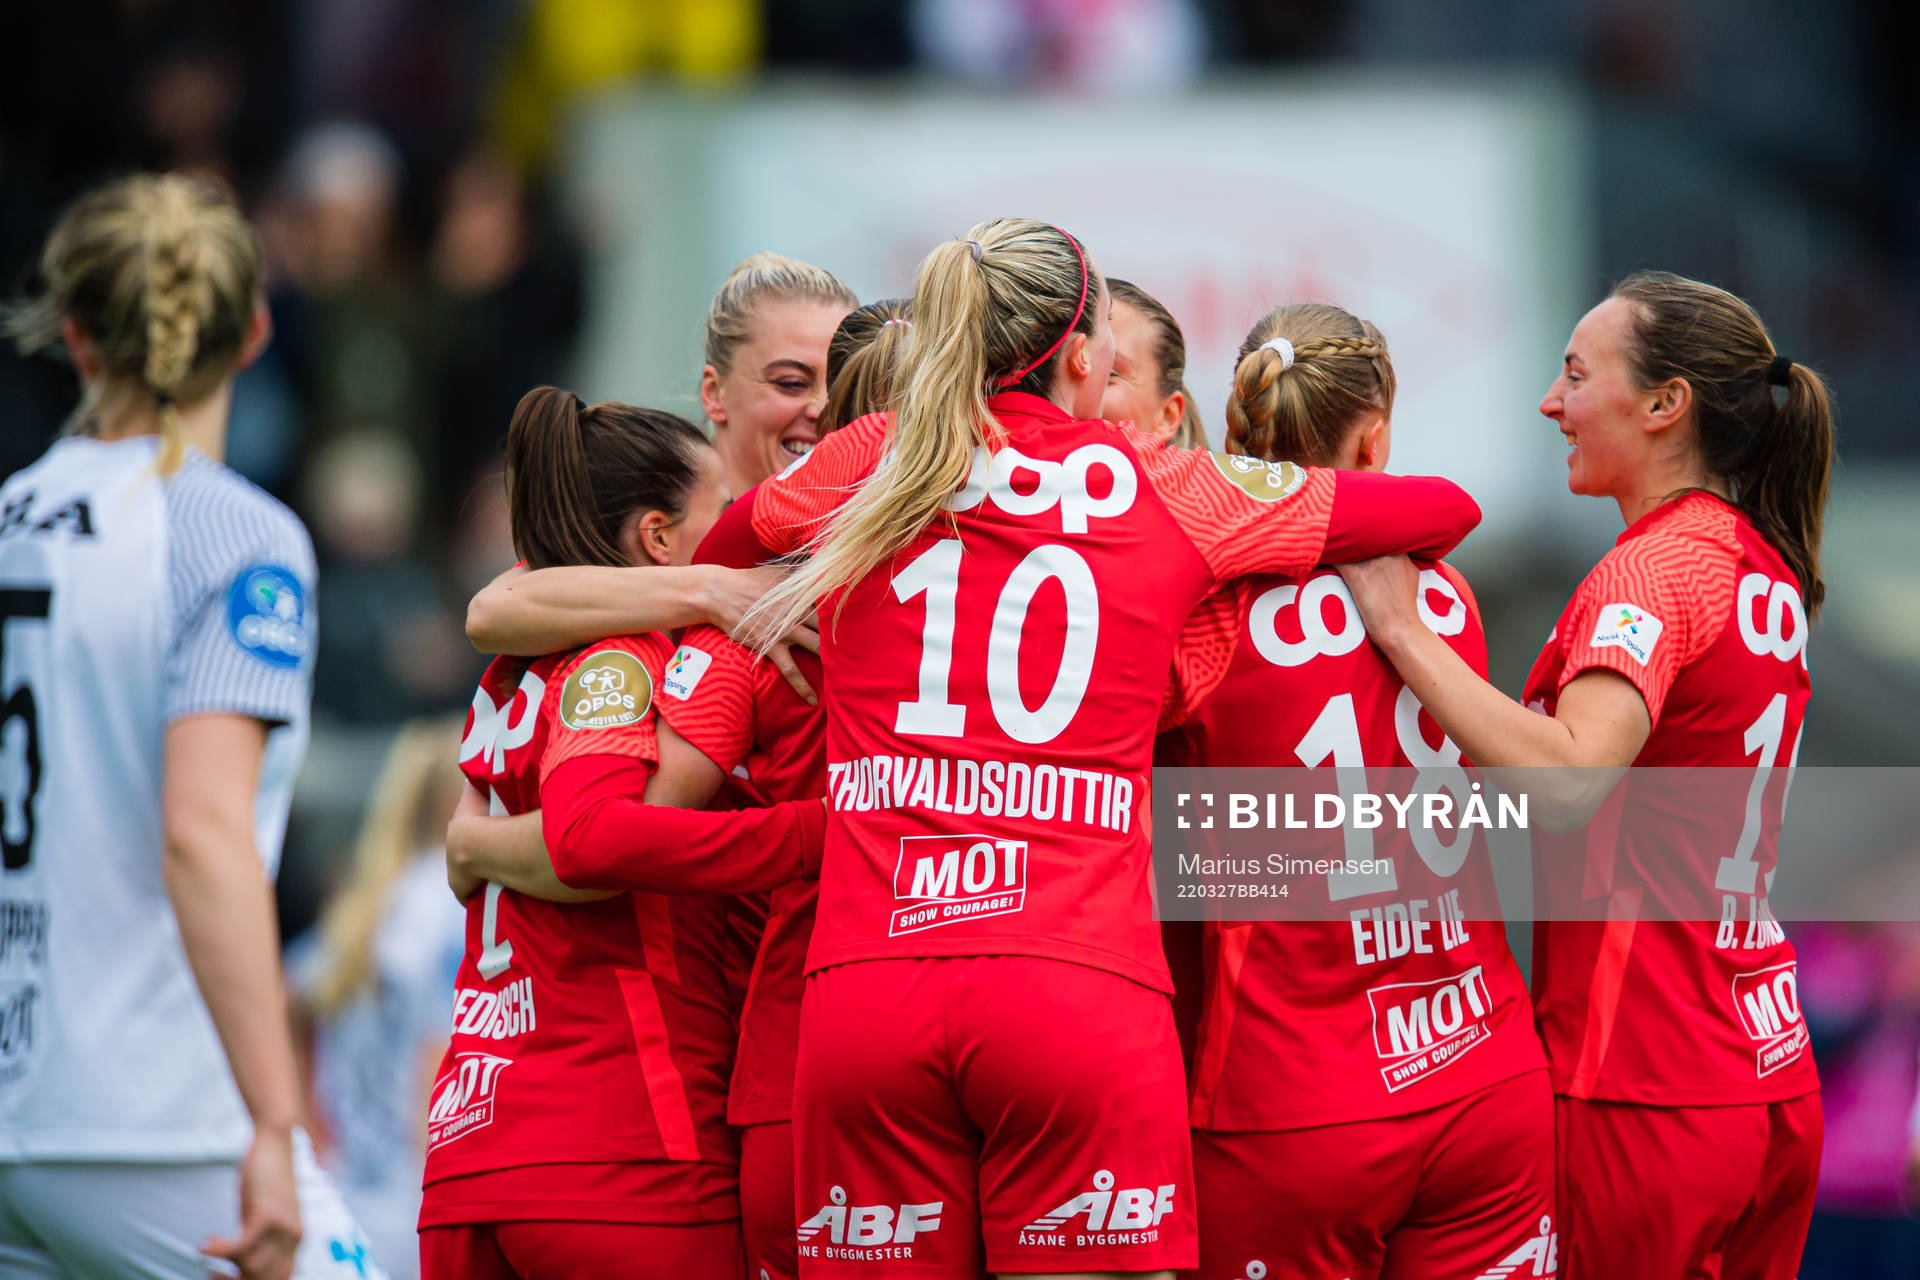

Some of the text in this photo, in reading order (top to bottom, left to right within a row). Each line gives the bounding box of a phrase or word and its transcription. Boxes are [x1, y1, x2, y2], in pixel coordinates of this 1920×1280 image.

[891, 539, 1099, 744] 10
[1622, 633, 1646, 660] Tipping
[575, 692, 635, 715] OBOS
[828, 755, 1132, 834] THORVALDSDOTTIR
[910, 841, 1027, 898] MOT
[900, 896, 1014, 928] SHOW COURAGE!
[1350, 889, 1470, 965] EIDE LIE
[1715, 895, 1739, 949] B.
[451, 976, 536, 1040] EDISCH
[1387, 966, 1485, 1056] MOT
[1743, 970, 1799, 1038] MO
[428, 1057, 511, 1123] MOT
[1392, 1057, 1428, 1082] SHOW
[826, 1247, 913, 1261] BYGGMESTER
[1018, 1230, 1159, 1247] ÅSANE BYGGMESTER
